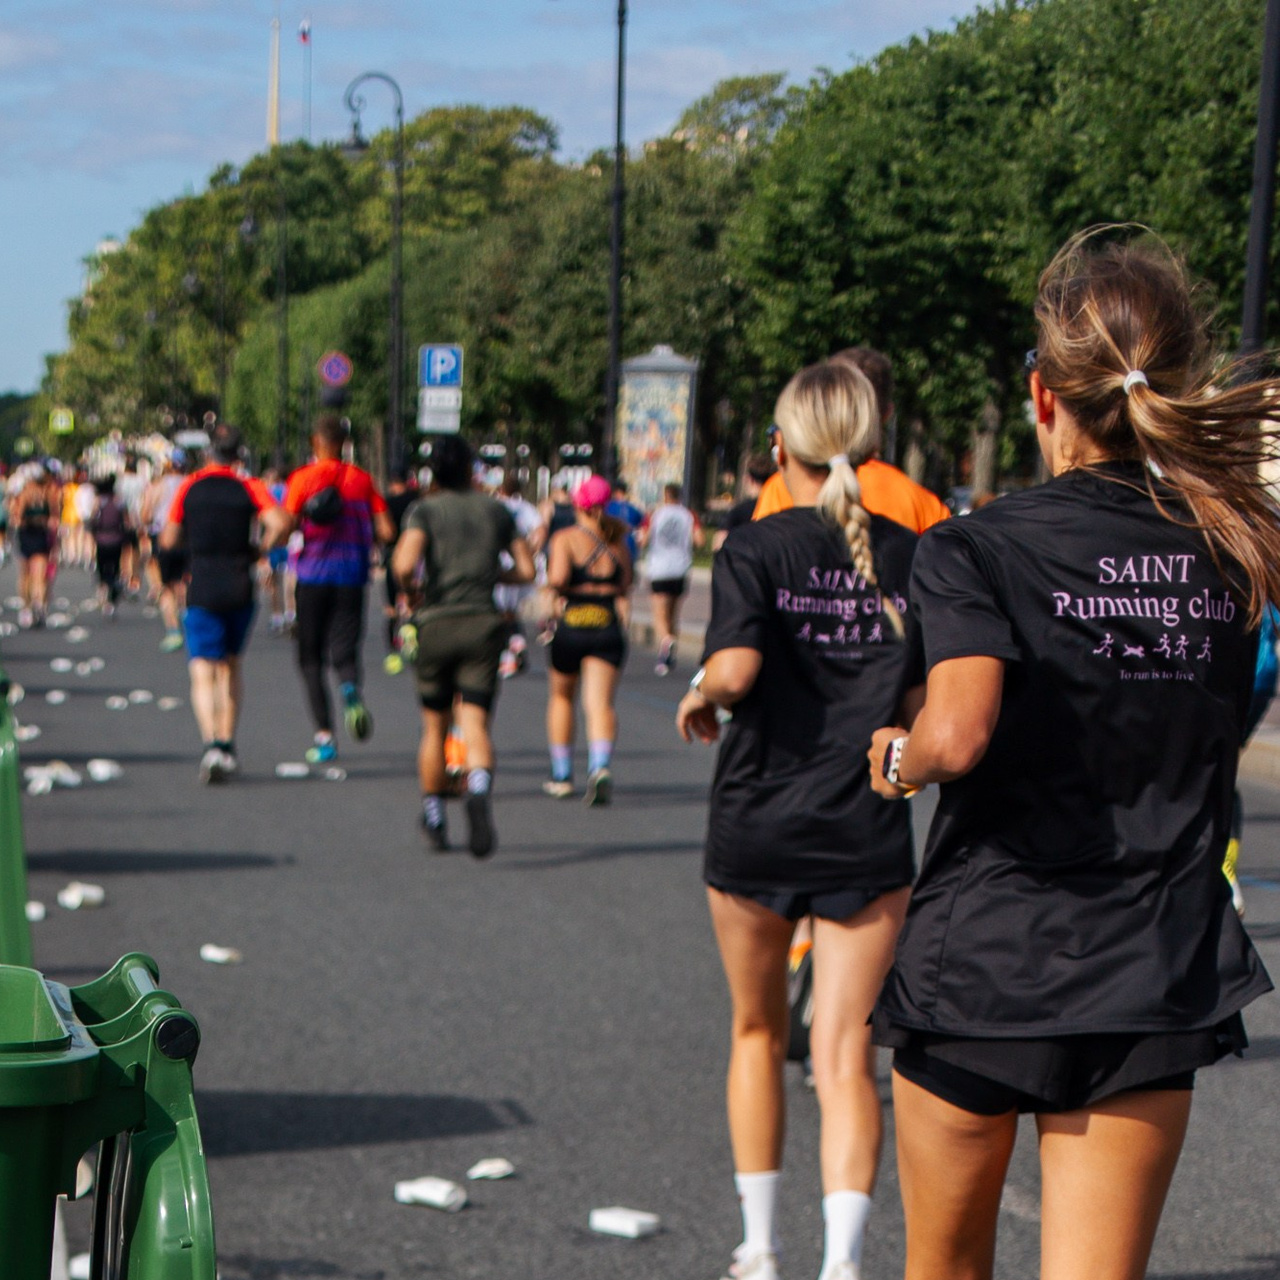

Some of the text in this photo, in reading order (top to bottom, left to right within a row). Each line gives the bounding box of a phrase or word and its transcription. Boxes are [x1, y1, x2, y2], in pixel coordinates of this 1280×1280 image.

[431, 347, 456, 384] P
[1098, 555, 1195, 584] SAINT
[777, 588, 907, 621] Running clb
[1052, 588, 1235, 627] Running club
[1119, 668, 1195, 681] To run is to live
